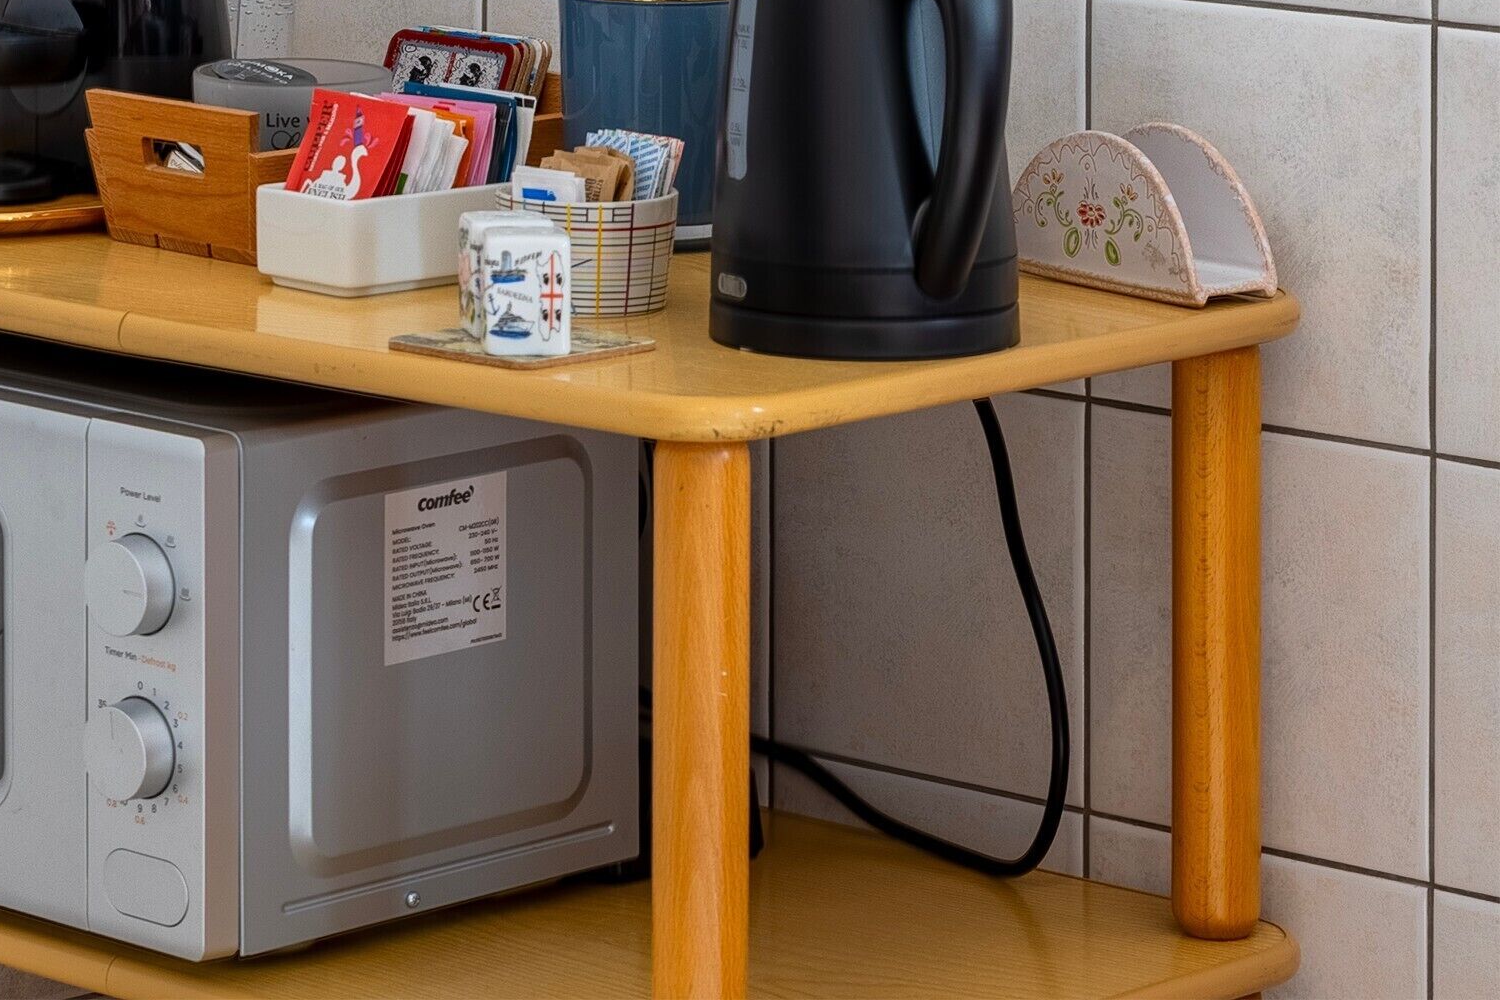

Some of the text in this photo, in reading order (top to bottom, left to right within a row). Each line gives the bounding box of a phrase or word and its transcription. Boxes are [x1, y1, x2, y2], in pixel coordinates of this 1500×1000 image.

[266, 113, 301, 129] Live
[121, 486, 162, 503] Power Level
[392, 522, 436, 535] Microwave Oven
[392, 546, 409, 555] RATED
[392, 555, 409, 563] RATED
[392, 564, 409, 572] RATED
[392, 573, 409, 581] RATED
[392, 579, 424, 591] MICROWAVE
[392, 594, 406, 602] MADE
[412, 590, 427, 598] CHINA
[104, 645, 124, 658] Timer
[137, 681, 144, 691] 0
[164, 700, 170, 710] 2
[173, 718, 179, 728] 3
[177, 741, 183, 750] 4
[177, 764, 183, 773] 5
[172, 784, 179, 793] 6
[164, 796, 170, 807] 7
[136, 803, 143, 813] 9
[151, 803, 157, 814] 8
